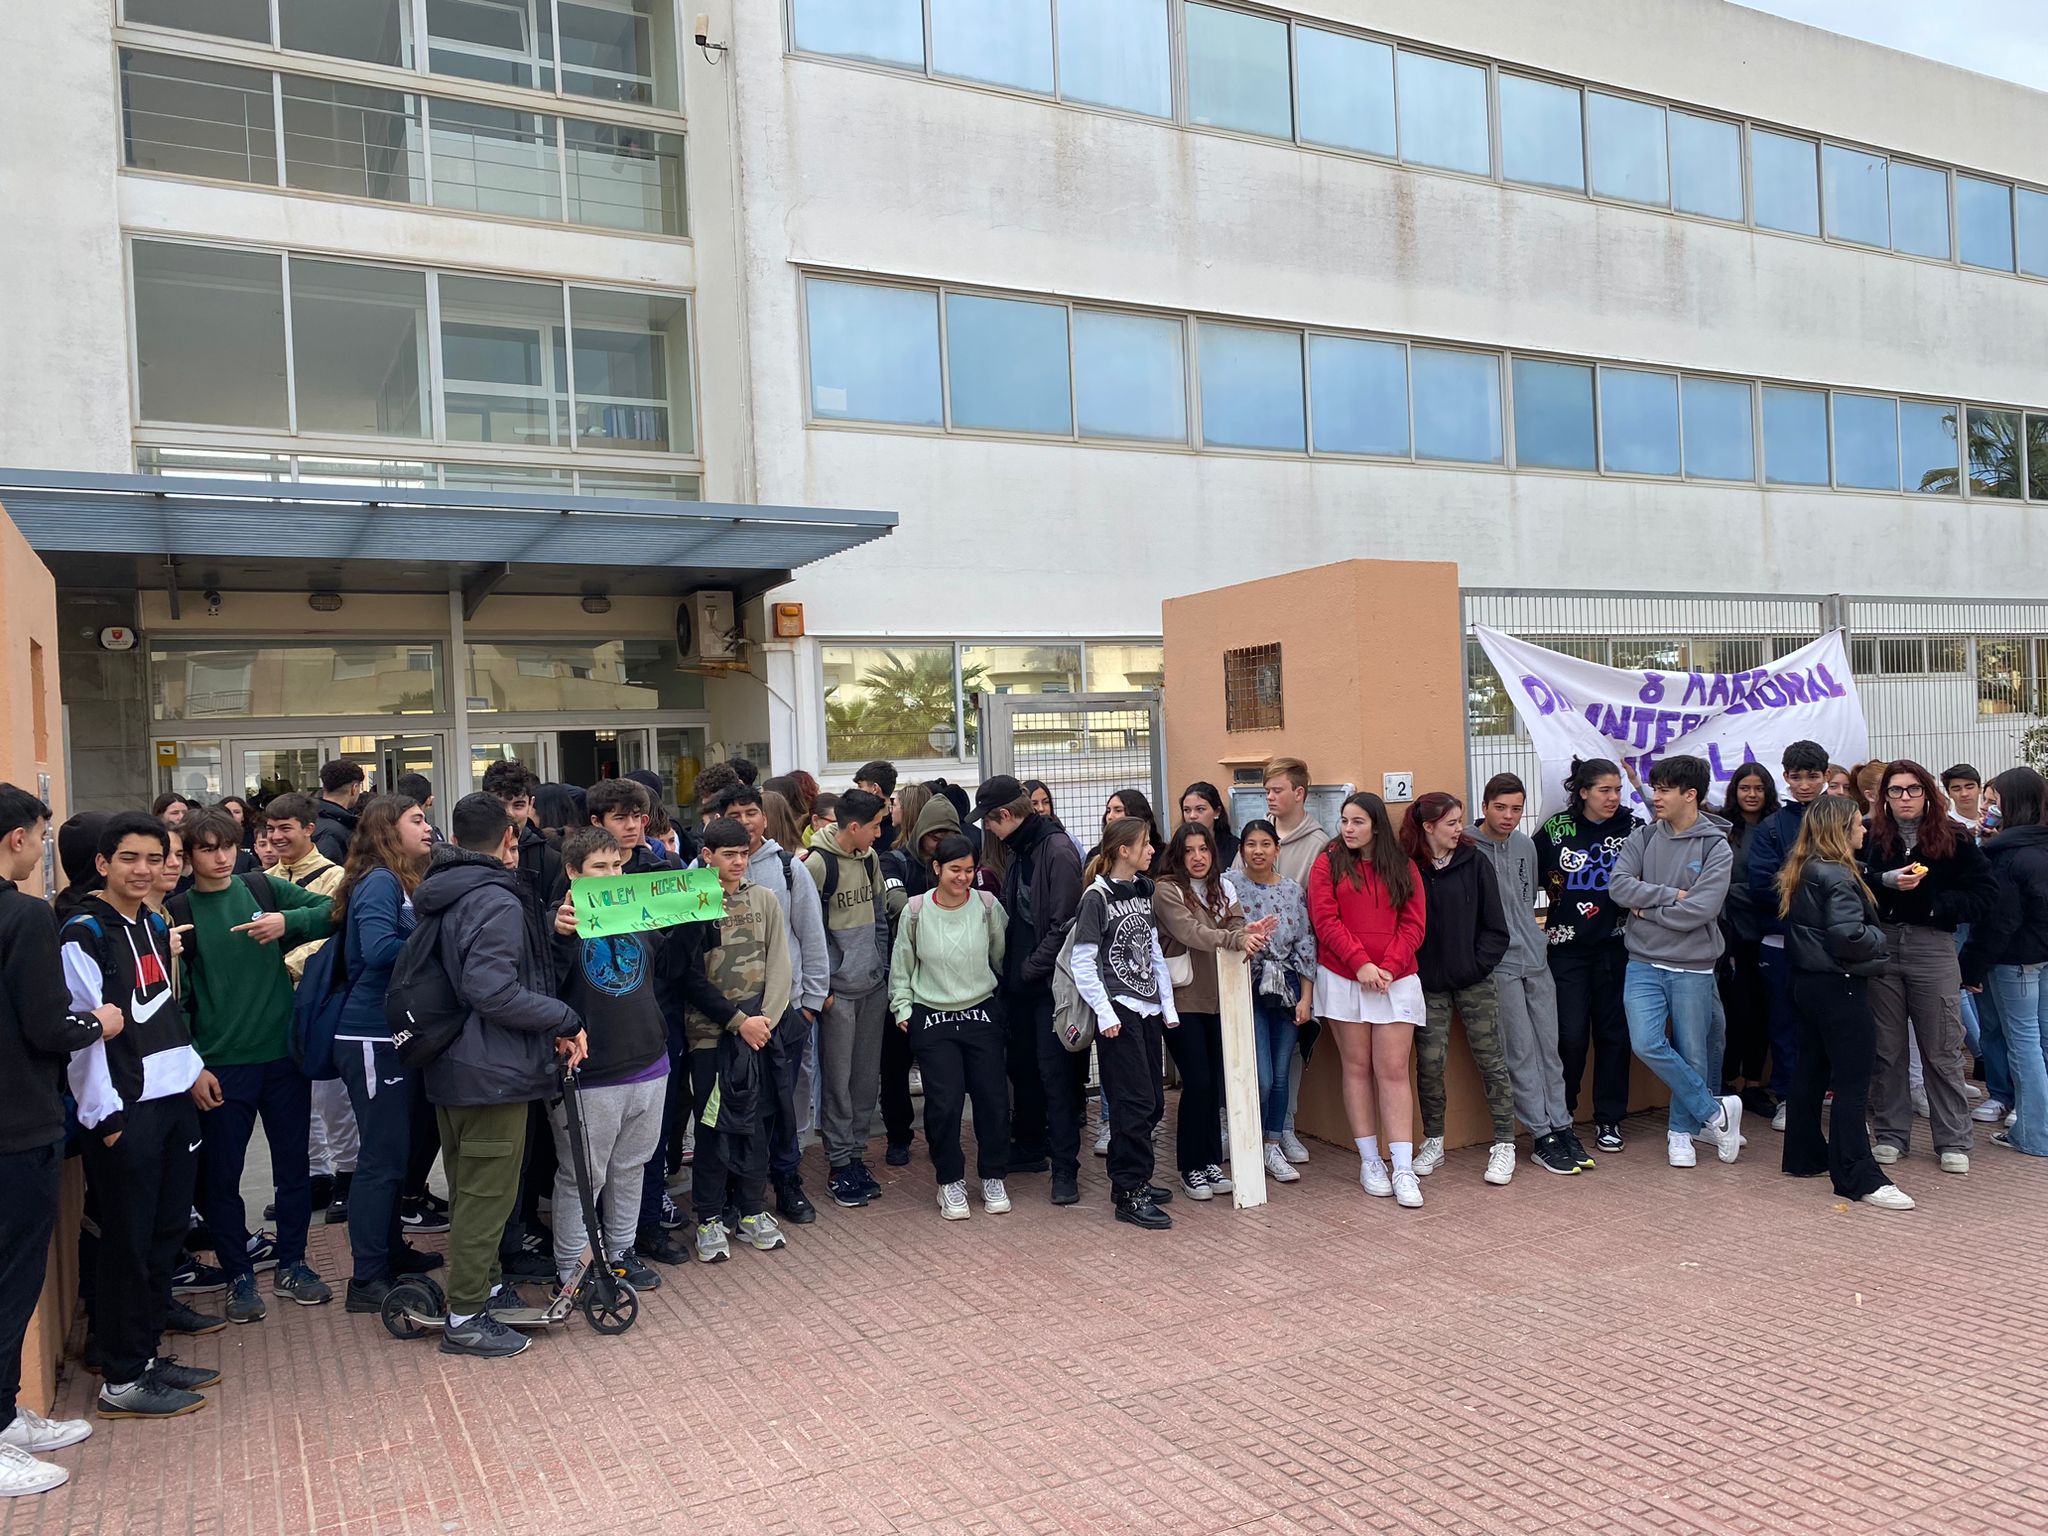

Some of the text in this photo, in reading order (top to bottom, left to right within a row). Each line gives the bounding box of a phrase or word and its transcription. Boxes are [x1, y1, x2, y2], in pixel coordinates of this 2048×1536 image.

[1638, 671, 1665, 704] 8
[1397, 781, 1407, 797] 2
[1566, 863, 1610, 891] LUC
[641, 906, 653, 921] A
